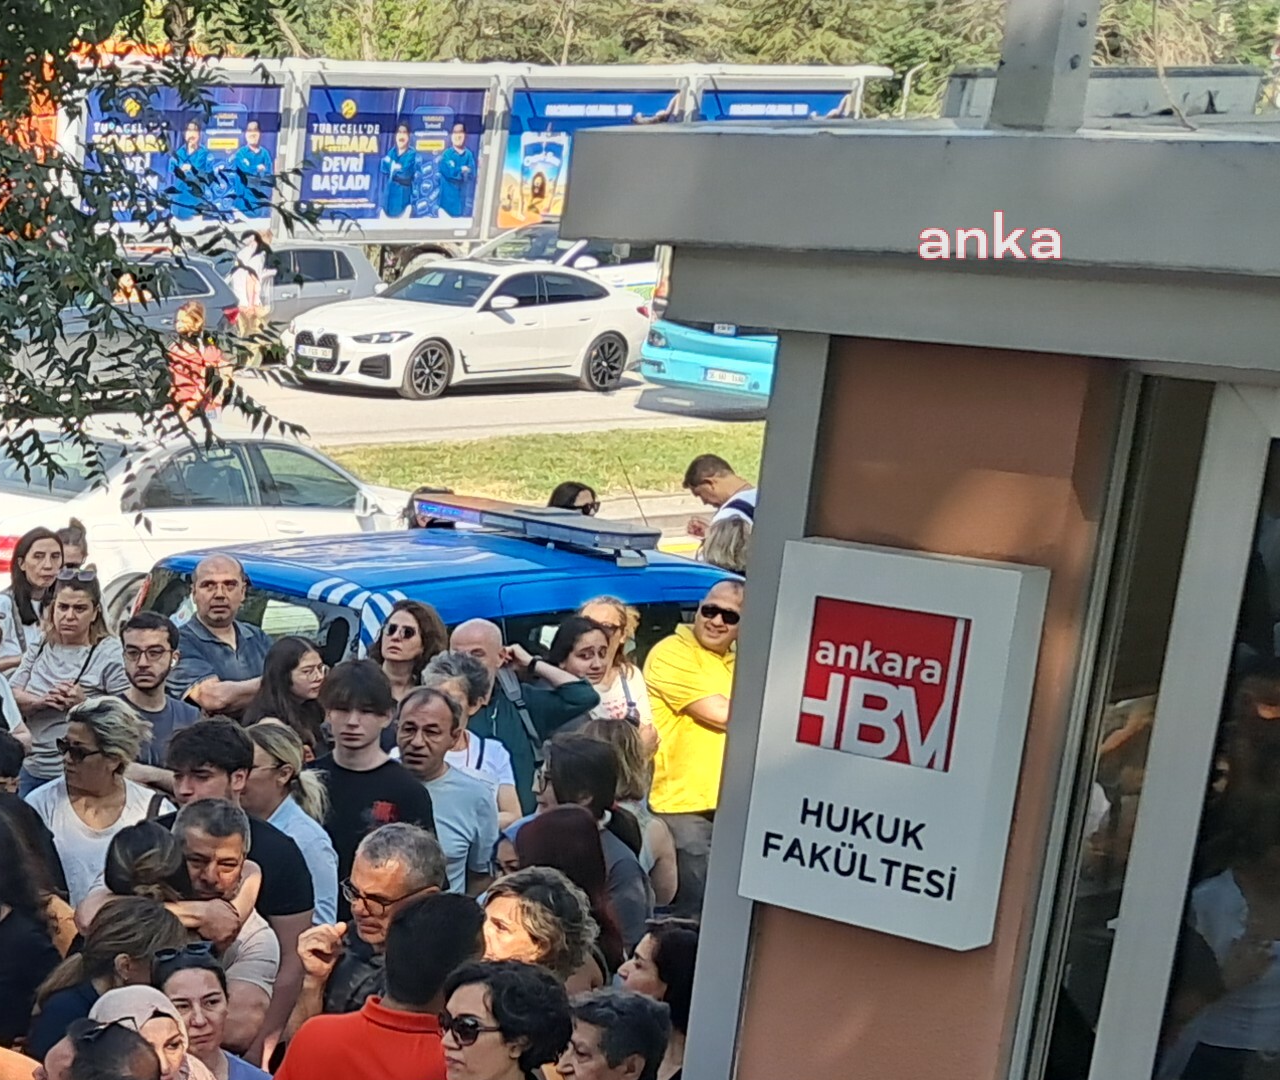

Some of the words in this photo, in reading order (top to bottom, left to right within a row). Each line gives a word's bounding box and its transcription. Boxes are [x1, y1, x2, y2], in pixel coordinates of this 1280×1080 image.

[311, 174, 370, 195] BAŞLADI
[322, 153, 364, 172] DEVRİ
[814, 639, 943, 685] ankara
[798, 672, 952, 772] HBV
[800, 797, 927, 851] HUKUK
[762, 831, 958, 901] FAKÜLTESİ
